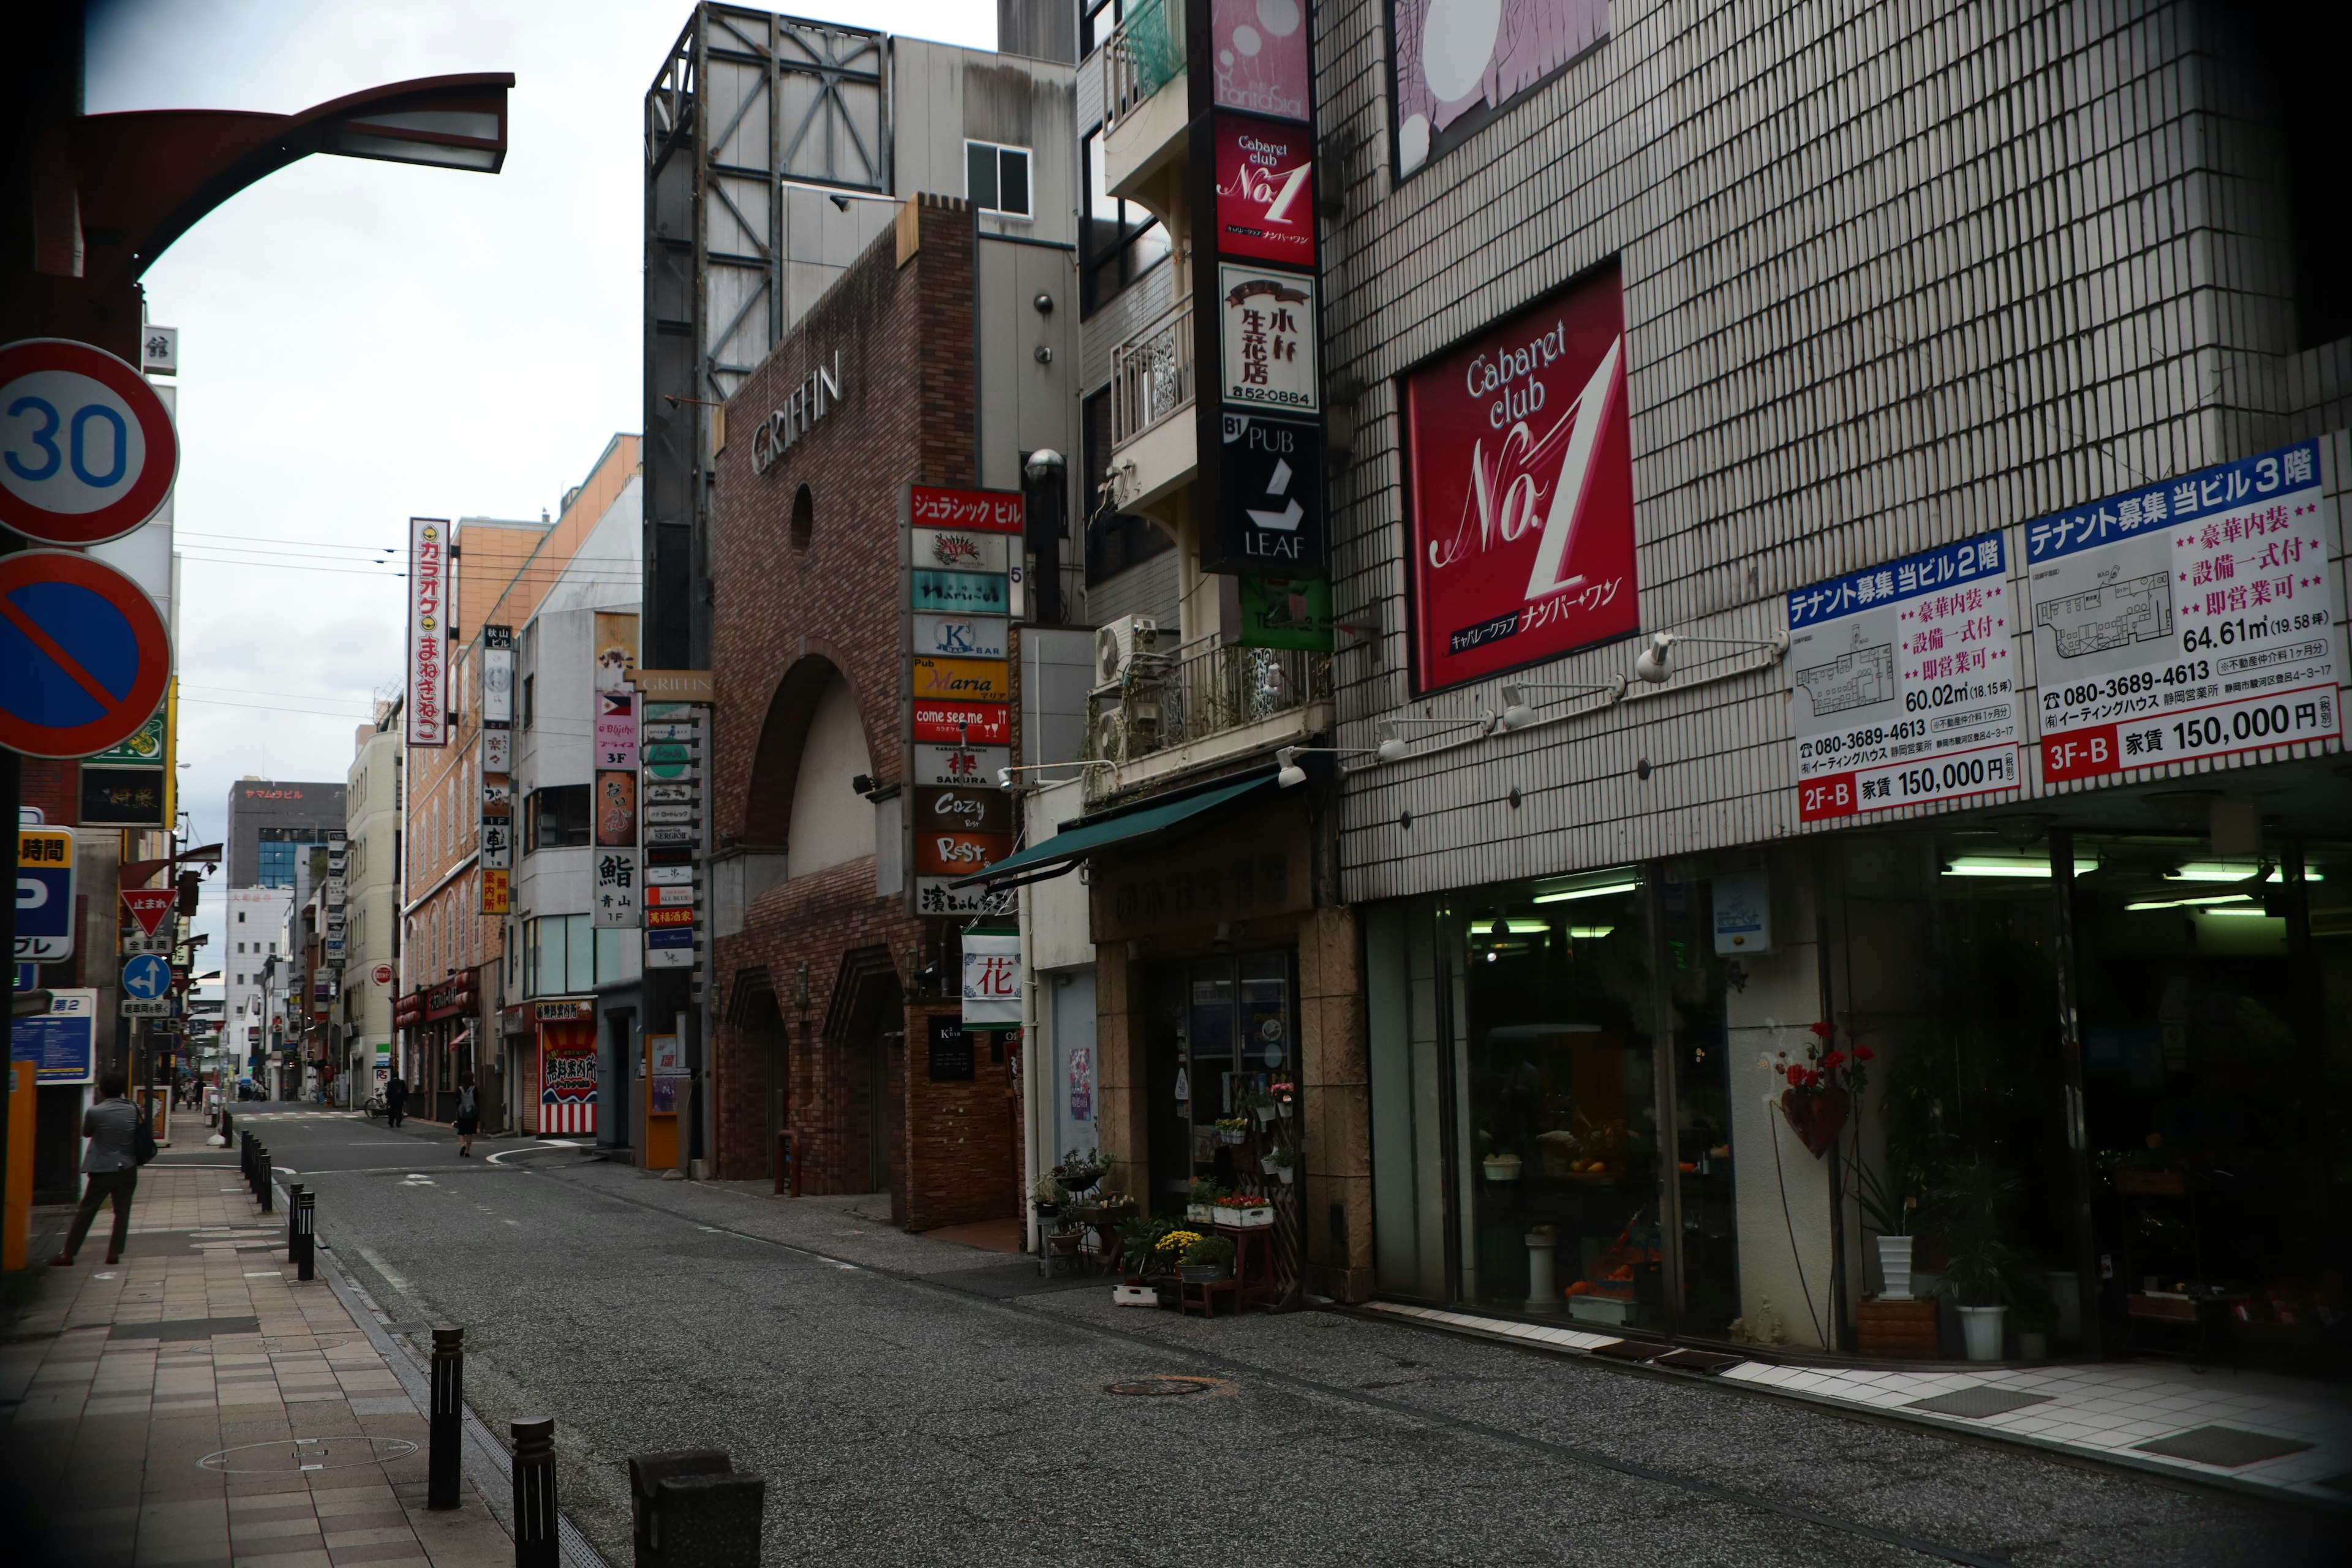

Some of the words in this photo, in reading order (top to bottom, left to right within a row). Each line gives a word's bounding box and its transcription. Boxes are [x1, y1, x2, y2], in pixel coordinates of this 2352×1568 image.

[1238, 135, 1287, 156] Cabaret
[1250, 151, 1278, 167] club
[1242, 308, 1268, 385] 生花店
[1466, 318, 1567, 399] Cabaret
[1490, 381, 1547, 431] club
[1224, 417, 1242, 435] B1
[1250, 426, 1294, 453] PUB
[4, 396, 127, 488] 30
[915, 494, 990, 522] ジュラシック
[995, 500, 1022, 524] ビル
[2030, 491, 2168, 556] テナント募集
[2200, 506, 2289, 550] 豪華内装
[1245, 530, 1305, 559] LEAF
[2192, 536, 2304, 586] 設備一式付
[420, 541, 440, 616] カラオケ
[1791, 570, 1894, 624] テナント募集
[1918, 587, 1983, 624] 豪華内装
[2206, 574, 2294, 617] 即営業可
[488, 628, 508, 638] 秋山
[492, 638, 510, 647] ビル
[1451, 614, 1518, 650] キャバレークラブ
[1913, 616, 1993, 655] 設備一式付
[914, 659, 935, 668] Pub
[1923, 647, 1988, 682] 即営業可
[416, 634, 440, 740] まねきねこ
[643, 677, 712, 691] GRIFFIN
[925, 669, 992, 691] Maria
[2064, 660, 2209, 707] 080-3689-4613
[916, 710, 944, 723] come
[967, 711, 983, 724] me
[1815, 719, 1926, 757] 080-3689-4613
[2050, 736, 2109, 772] 3F-B
[2125, 728, 2163, 756] 家賃
[607, 753, 627, 763] 3F
[245, 790, 304, 800] ヤマムラビル
[935, 792, 985, 821] Cozy
[1804, 783, 1850, 812] 2F-B
[1862, 777, 1891, 800] 家賃
[17, 838, 64, 862] 時間
[484, 827, 507, 857] 車
[598, 856, 634, 888] 鮨
[133, 899, 167, 910] 止まれ
[484, 871, 496, 911] 案内所
[497, 877, 508, 906] 無料
[600, 894, 630, 908] 青山
[650, 910, 692, 924] 萬福酒家
[129, 940, 168, 951] 全車両
[976, 957, 1014, 995] 花
[52, 999, 80, 1012] 第2
[124, 1003, 168, 1014] 軽車両を除く
[546, 1054, 597, 1085] 無料案内所
